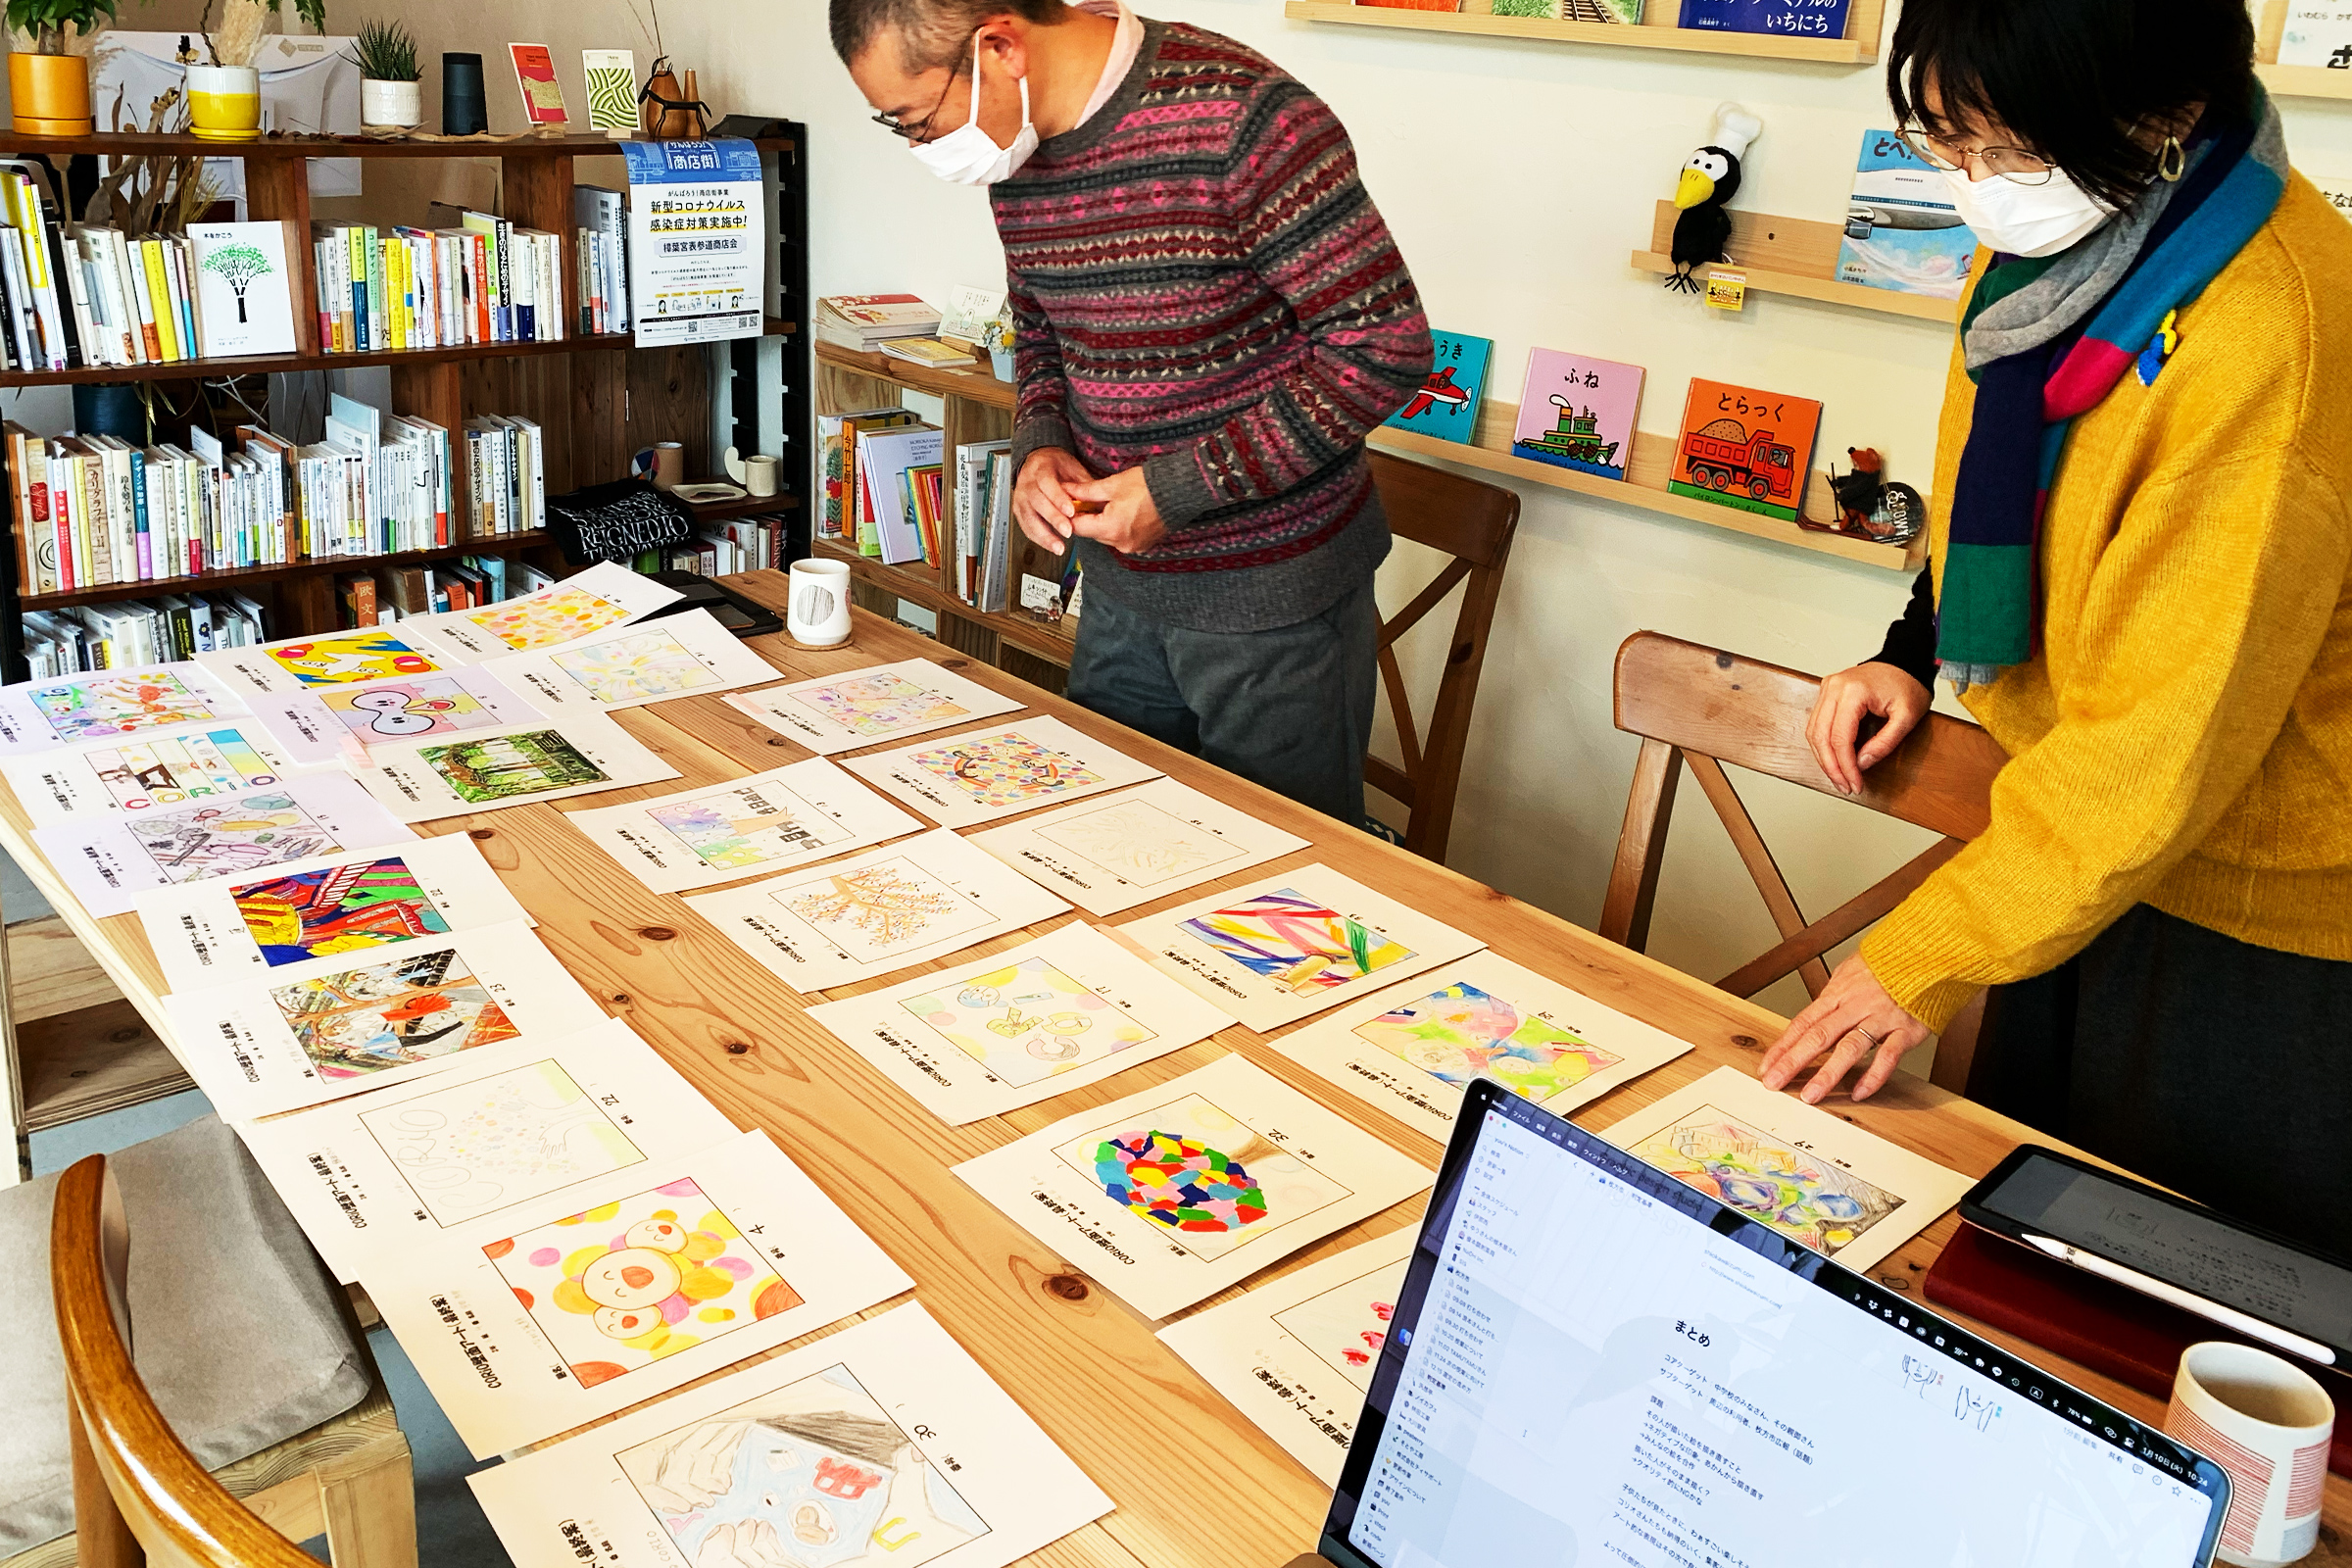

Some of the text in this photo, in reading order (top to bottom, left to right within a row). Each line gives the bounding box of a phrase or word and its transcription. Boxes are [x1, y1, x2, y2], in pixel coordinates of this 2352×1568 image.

[1766, 12, 1829, 33] いちにち
[672, 154, 714, 170] 商店街
[651, 200, 745, 213] 新型コロナウイルス
[1564, 368, 1599, 389] ふね
[1718, 393, 1785, 422] とらっく
[359, 585, 375, 628] 欧文
[1675, 1320, 1711, 1348] まとめ
[914, 1424, 937, 1442] 30
